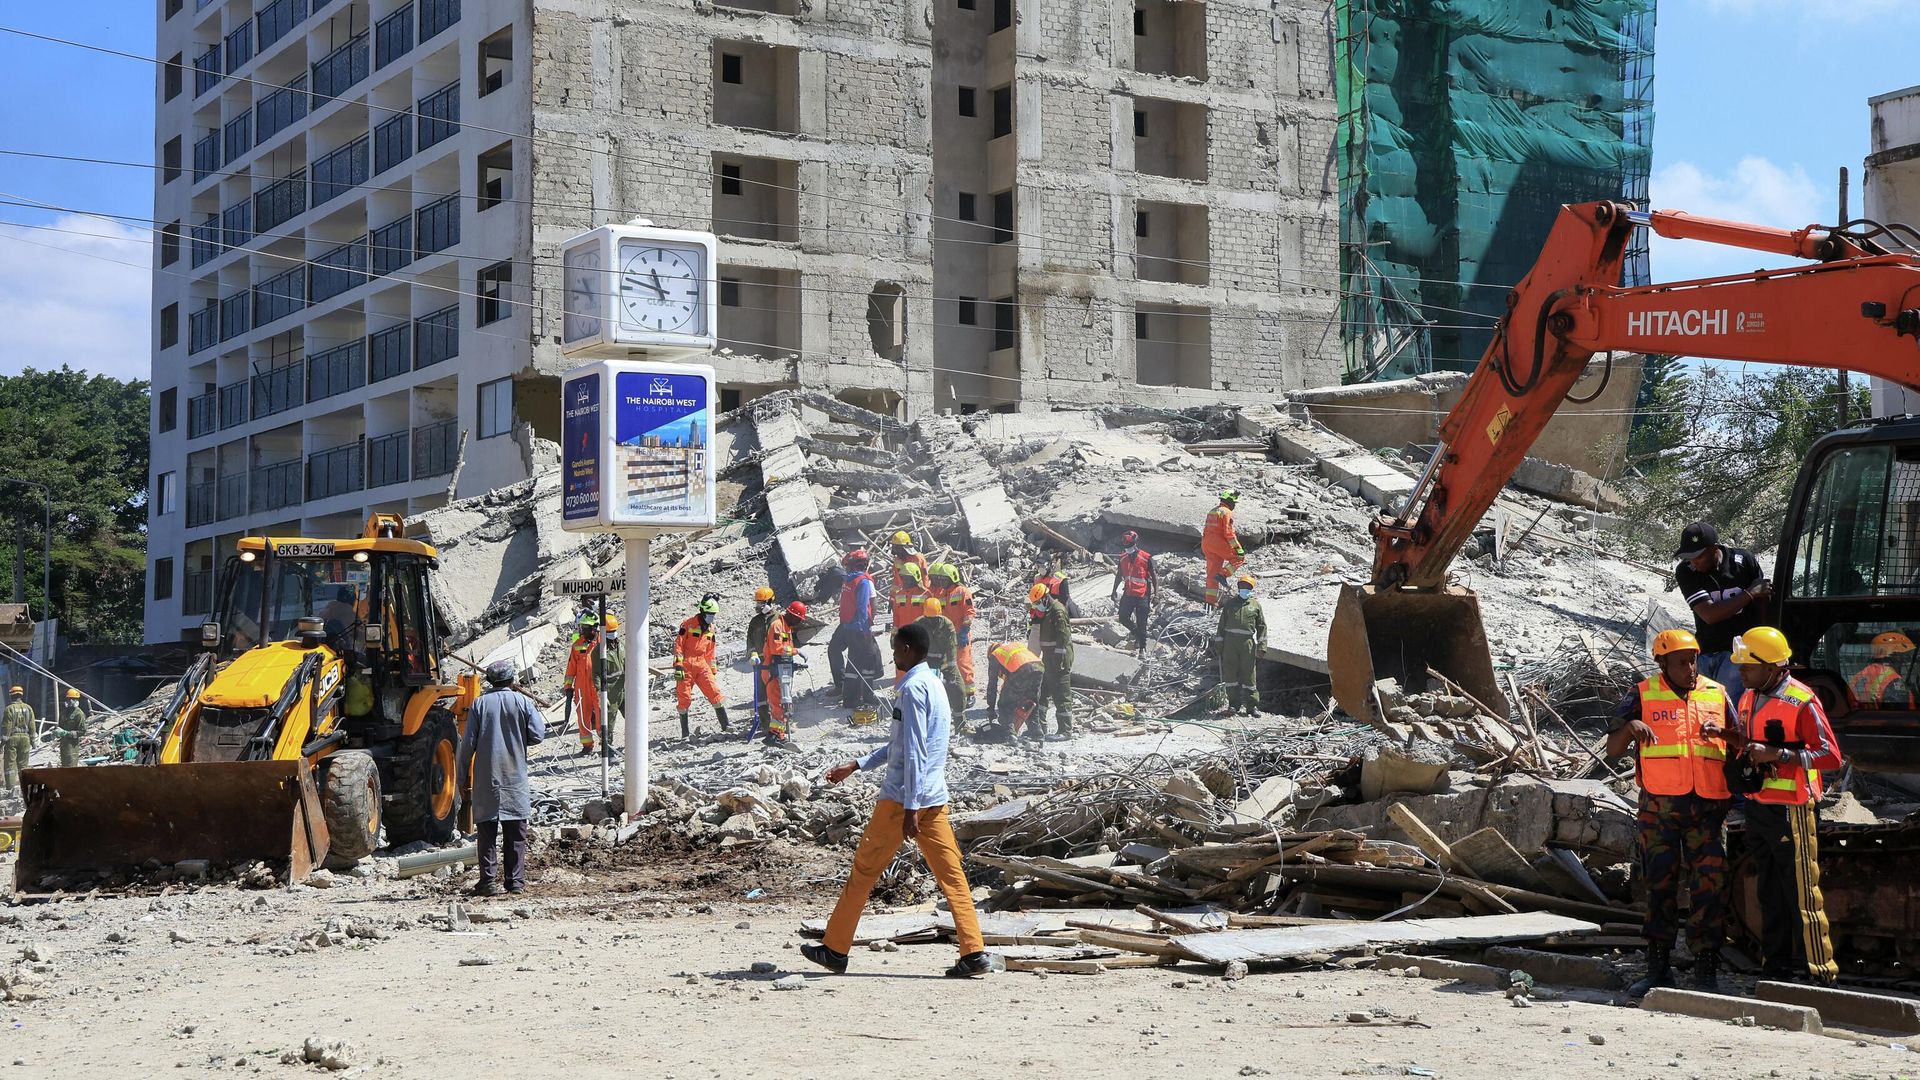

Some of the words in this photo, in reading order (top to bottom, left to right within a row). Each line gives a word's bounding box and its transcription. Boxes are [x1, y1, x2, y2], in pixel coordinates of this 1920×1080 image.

[1628, 309, 1728, 336] HITACHI
[626, 396, 640, 405] THE
[643, 397, 674, 406] NAIROBI
[676, 399, 696, 407] WEST
[566, 409, 574, 418] THE
[565, 495, 579, 507] 0730
[580, 492, 589, 504] 600
[590, 491, 599, 502] 000
[278, 544, 299, 555] GKB
[306, 544, 334, 555] 340W
[562, 580, 604, 594] MUHOHO
[610, 579, 626, 591] AVE
[319, 664, 338, 697] JCB
[1652, 710, 1678, 721] DRU
